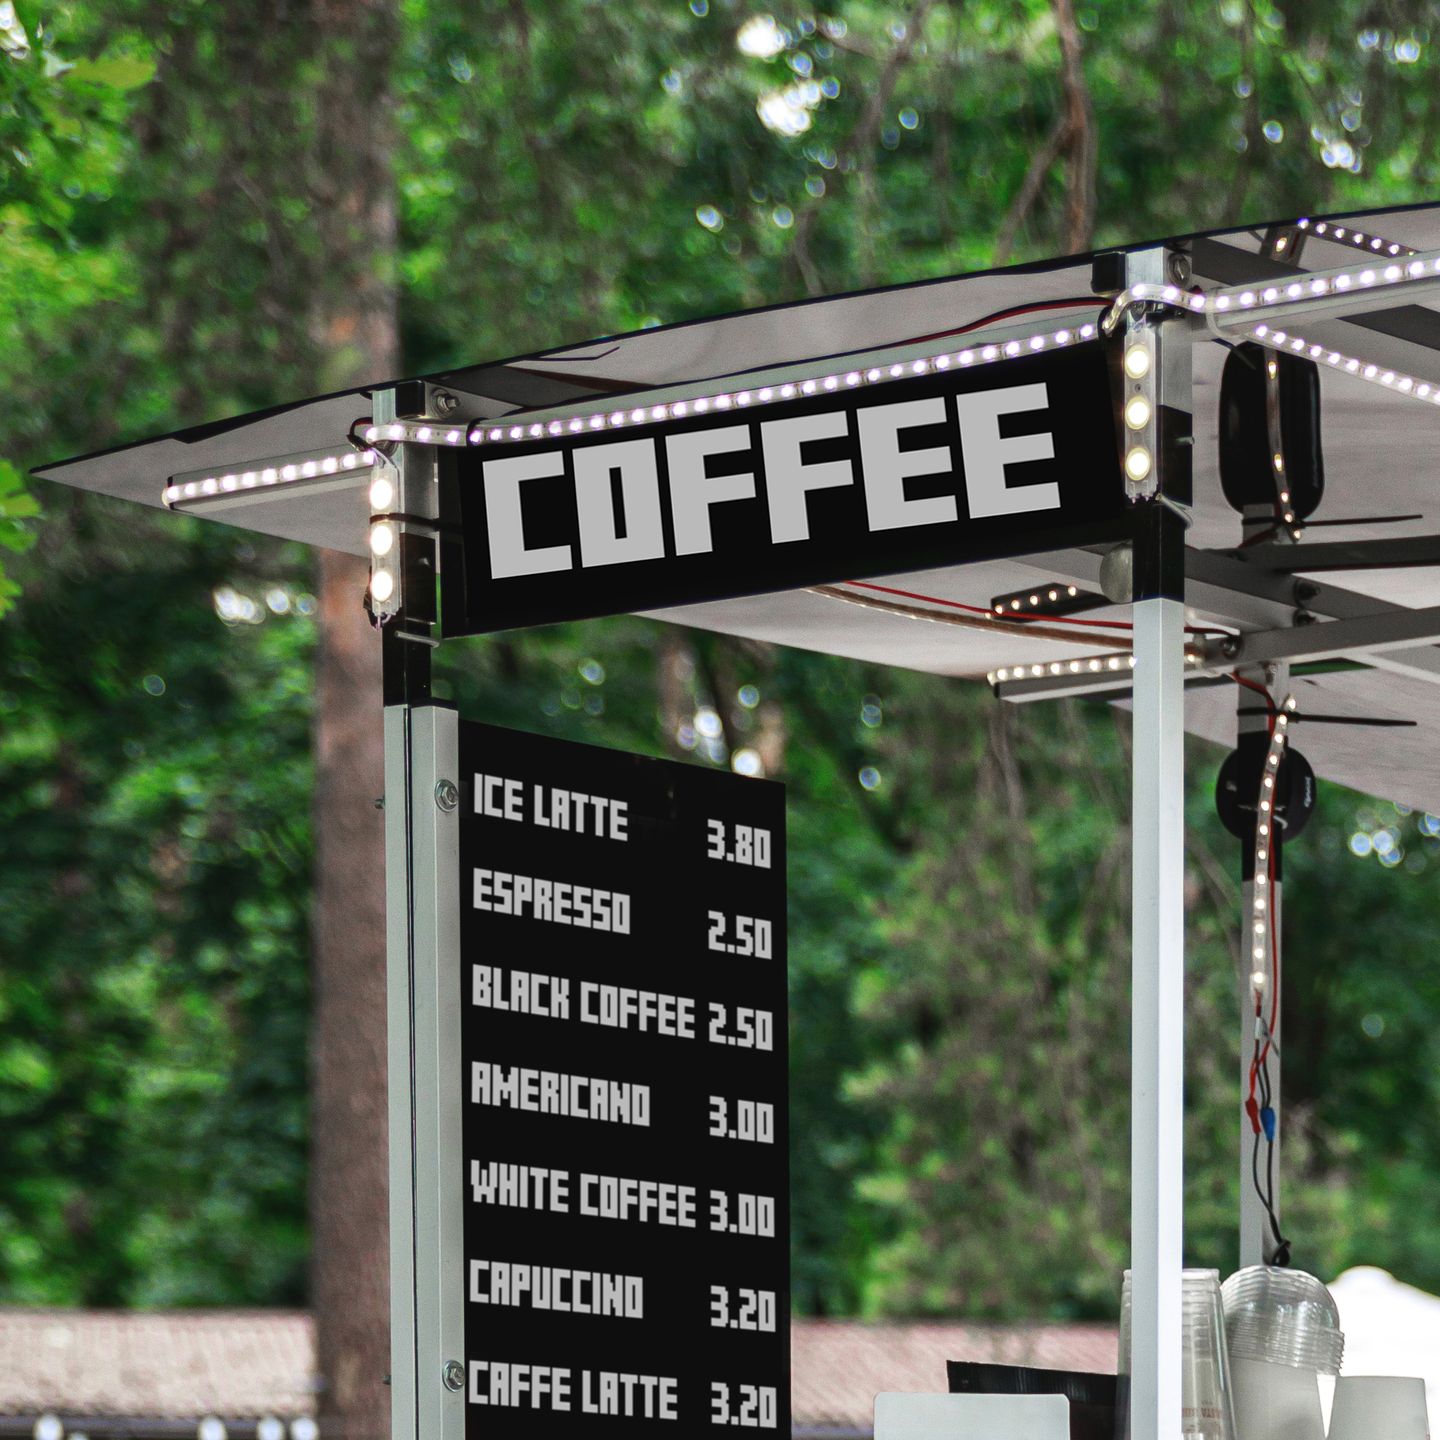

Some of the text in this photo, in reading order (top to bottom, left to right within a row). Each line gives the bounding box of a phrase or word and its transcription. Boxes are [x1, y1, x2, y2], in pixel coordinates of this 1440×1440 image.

[481, 381, 1062, 580] COFFEE
[474, 773, 771, 868] ICE LATTE 3.80
[473, 868, 771, 959] ESPRESSO 2.50
[473, 964, 772, 1051] BLACK COFFEE 2.50
[472, 1062, 773, 1143] AMERICANO 3.00
[471, 1160, 774, 1237] WHITE COFFEE 3.00
[470, 1260, 775, 1332] CAPUCCINO 3.20
[469, 1360, 776, 1428] CAFFE LATTE 3.20
